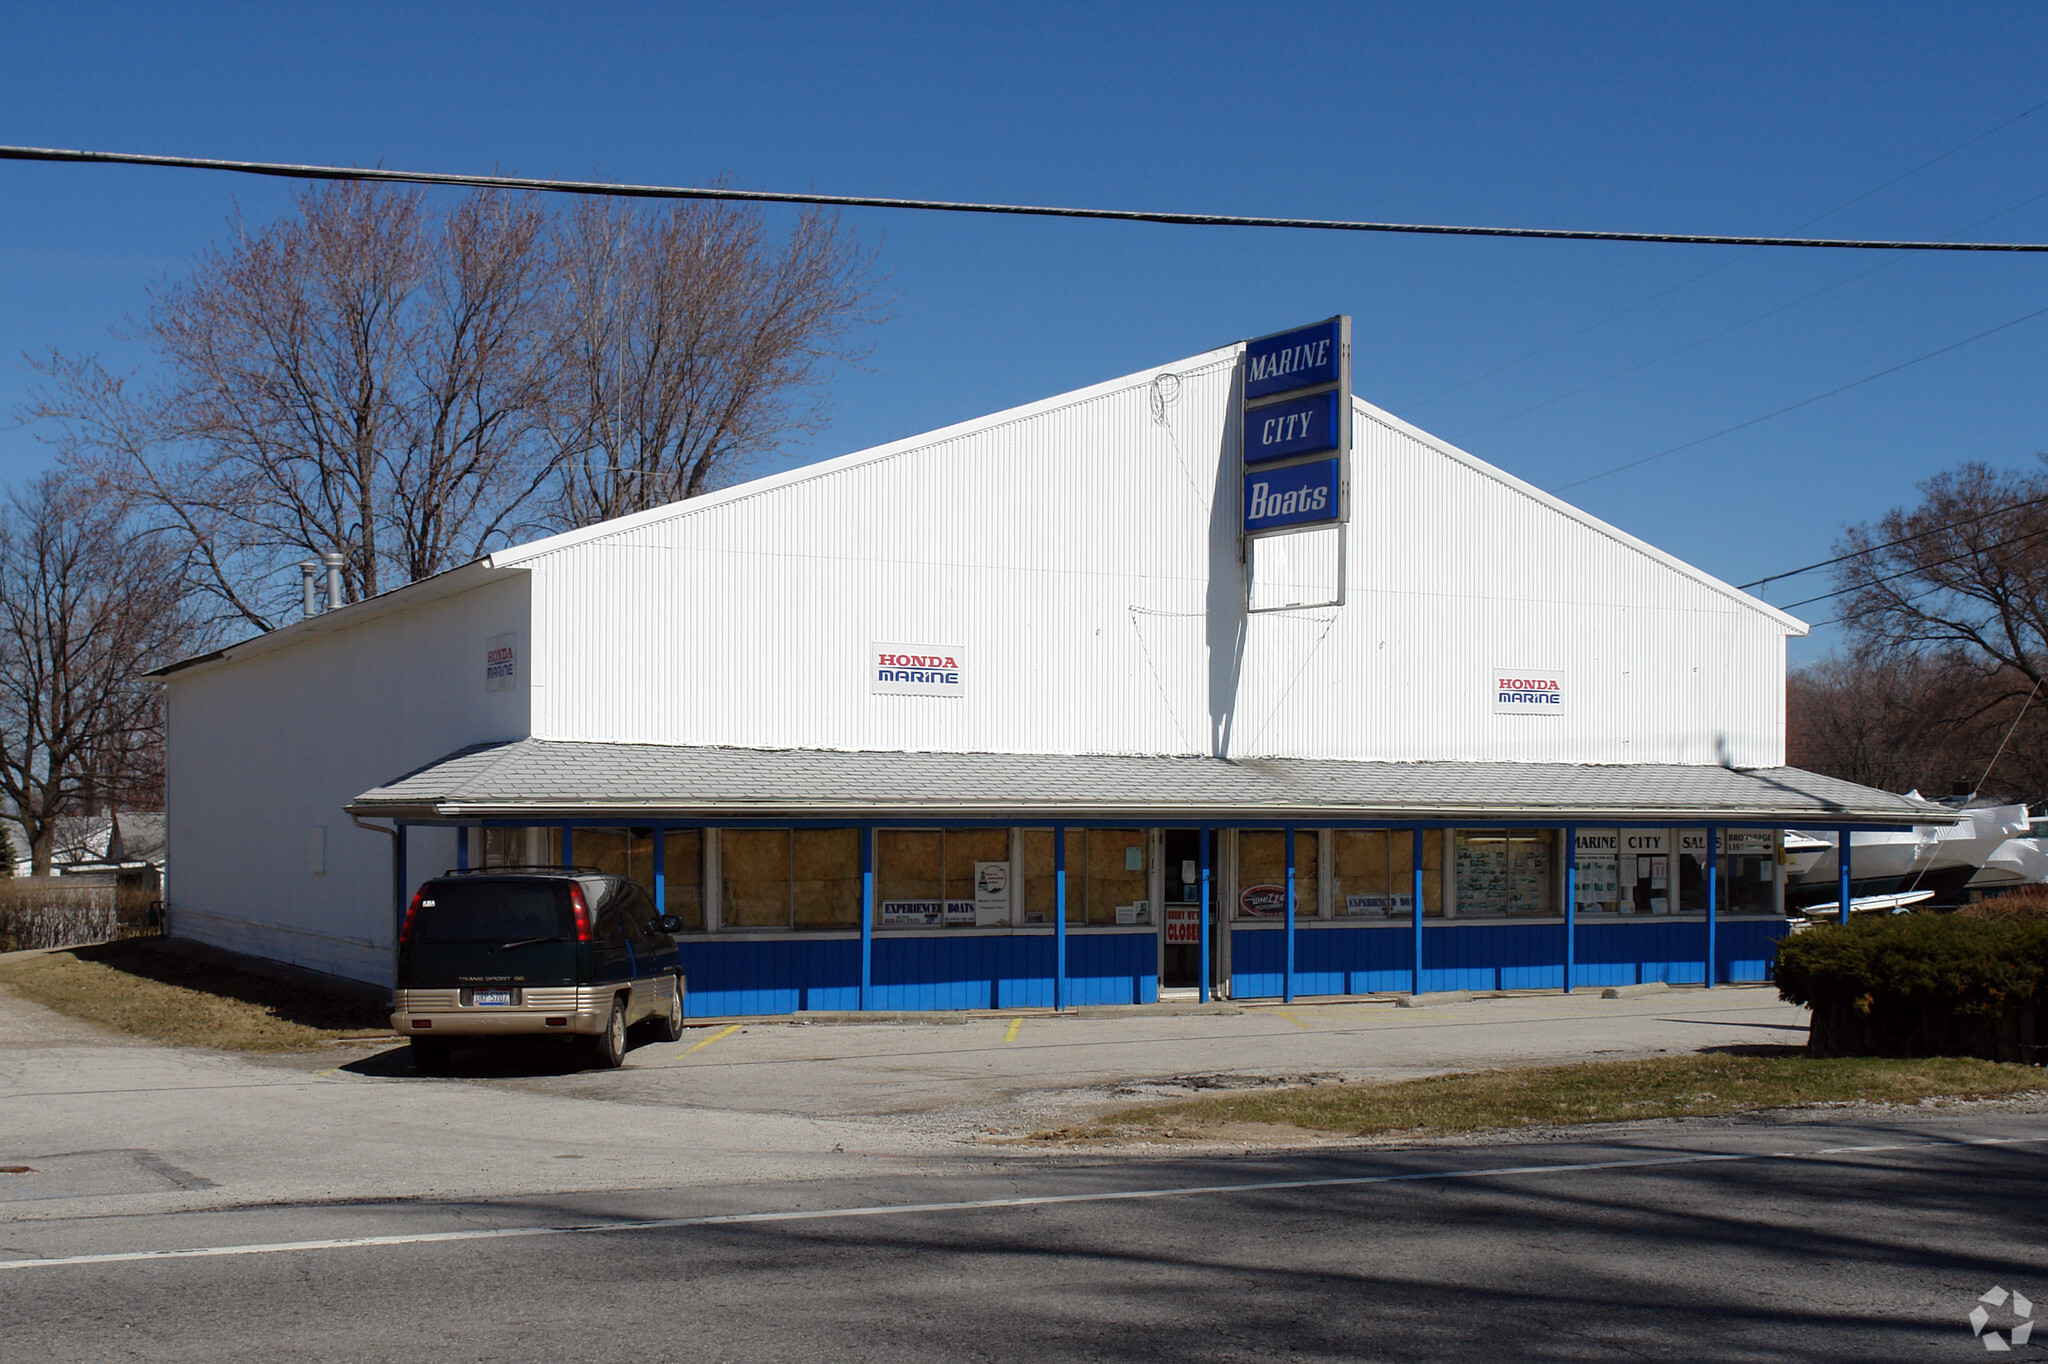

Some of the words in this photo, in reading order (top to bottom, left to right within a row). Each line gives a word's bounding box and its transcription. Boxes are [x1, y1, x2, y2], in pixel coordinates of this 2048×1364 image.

[1248, 339, 1330, 382] MARINE
[1262, 411, 1313, 445] CITY
[1248, 482, 1328, 519] Boats
[878, 654, 959, 668] HONDA
[878, 670, 959, 684] MARINE
[1498, 679, 1561, 690] HONDA
[1498, 692, 1561, 704] MARINE
[1628, 836, 1661, 848] CITY
[1682, 836, 1722, 848] SALS
[948, 902, 975, 914] BOATS
[1167, 910, 1185, 920] SORRY
